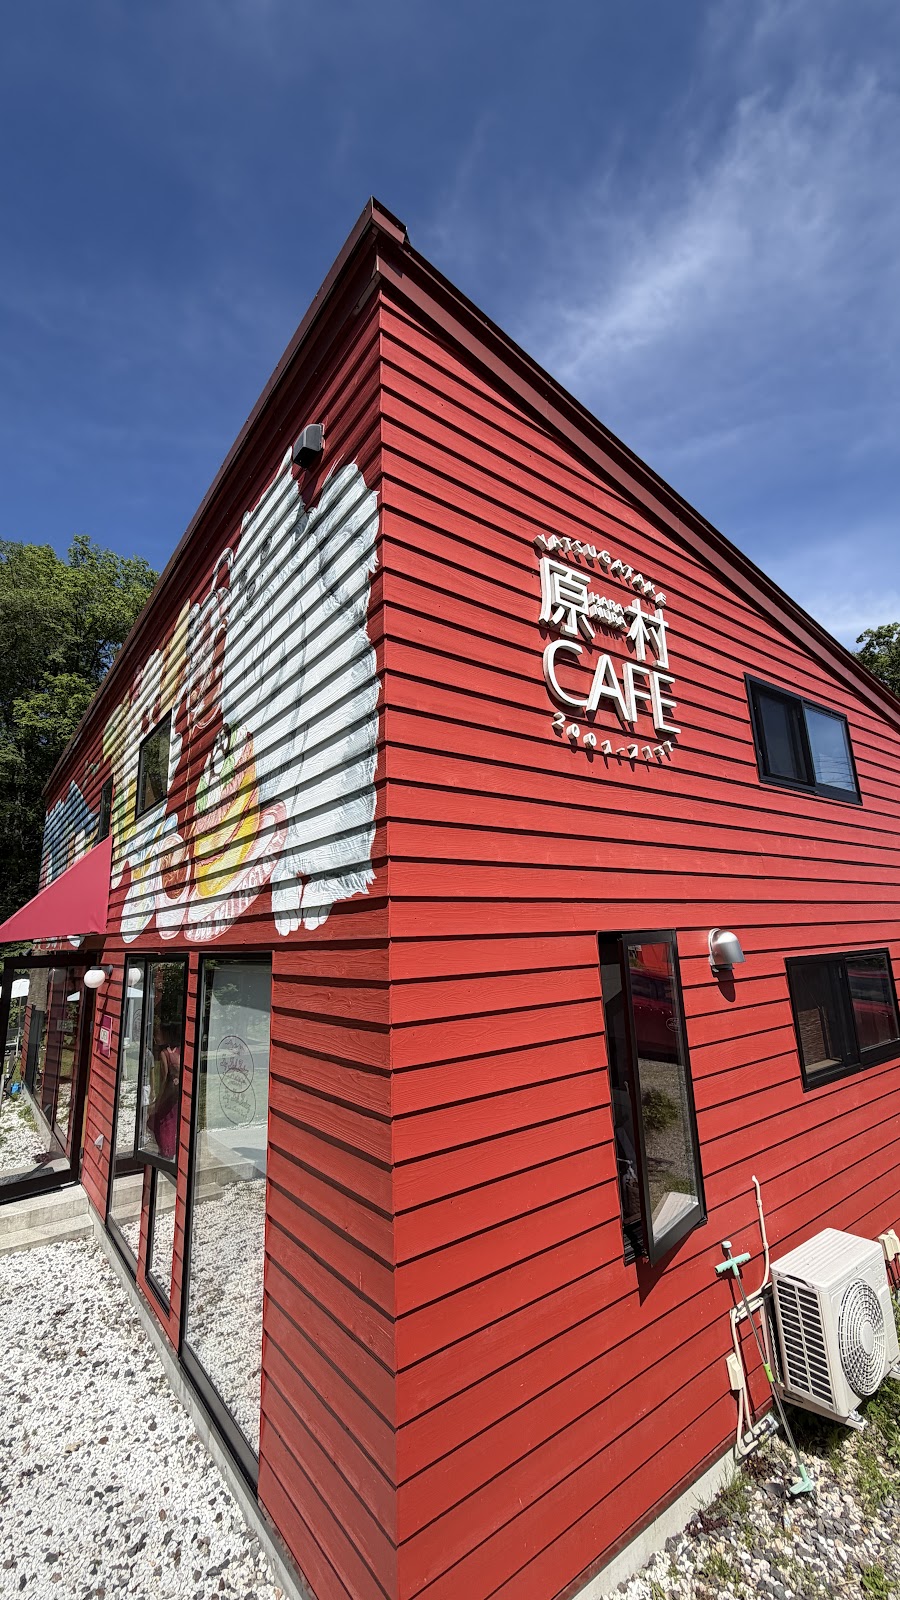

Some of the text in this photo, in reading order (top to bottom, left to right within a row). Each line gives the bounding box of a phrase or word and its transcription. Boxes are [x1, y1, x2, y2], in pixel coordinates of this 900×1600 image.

[533, 534, 667, 608] YATSUGATAKE
[588, 592, 625, 616] HARA
[543, 639, 682, 735] CAFE
